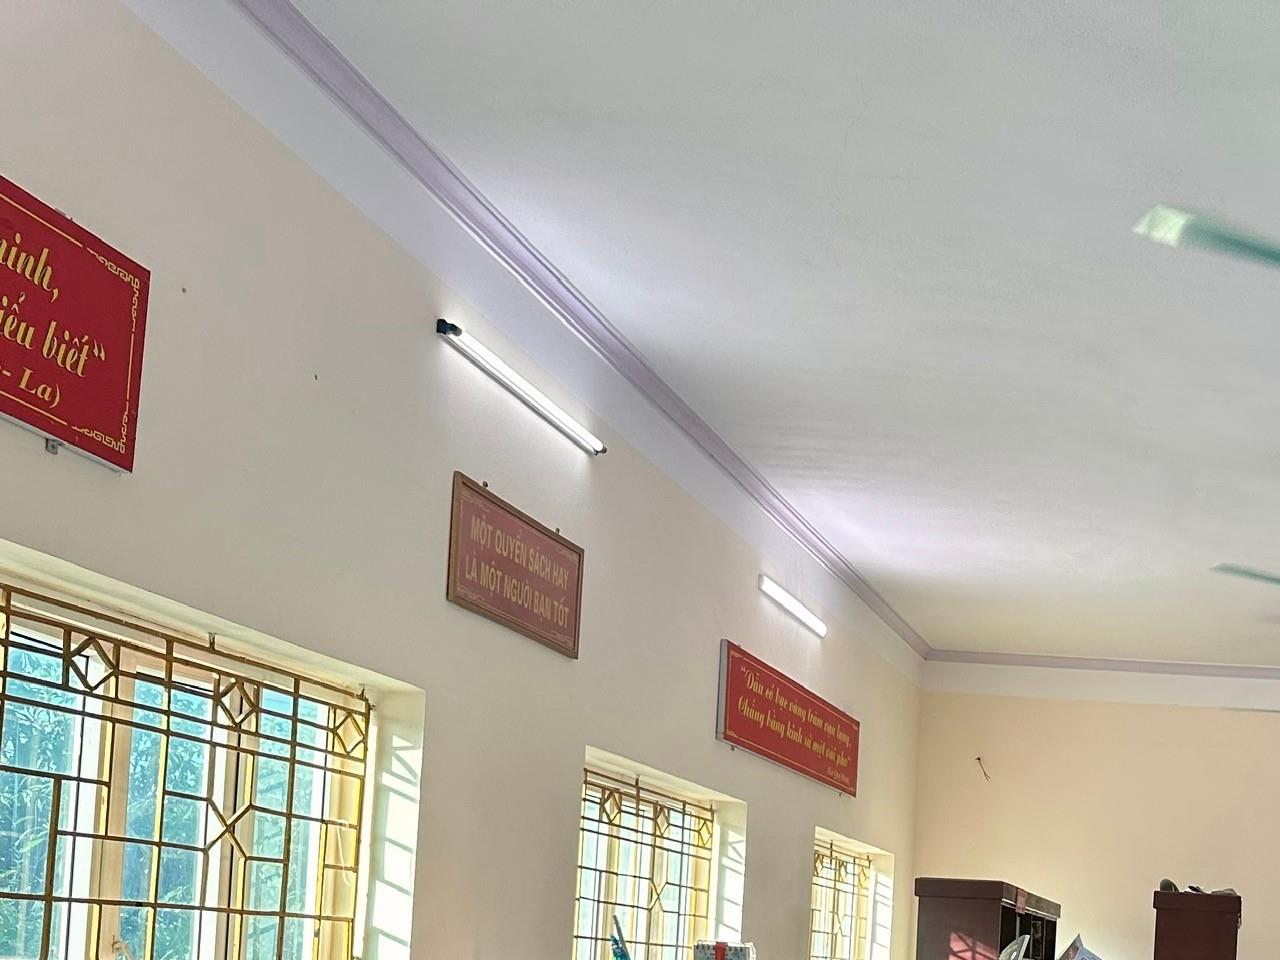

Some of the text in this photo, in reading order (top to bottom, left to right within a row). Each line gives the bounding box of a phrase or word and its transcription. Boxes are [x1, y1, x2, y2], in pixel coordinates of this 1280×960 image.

[0, 291, 35, 349] iểu
[18, 367, 60, 408] La)
[471, 515, 569, 591] MỘT QUYỂN SÁCH HAY
[465, 551, 478, 581] LÀ
[480, 561, 502, 598] MỘT
[534, 590, 551, 623] BẠN
[553, 595, 570, 628] TỐT
